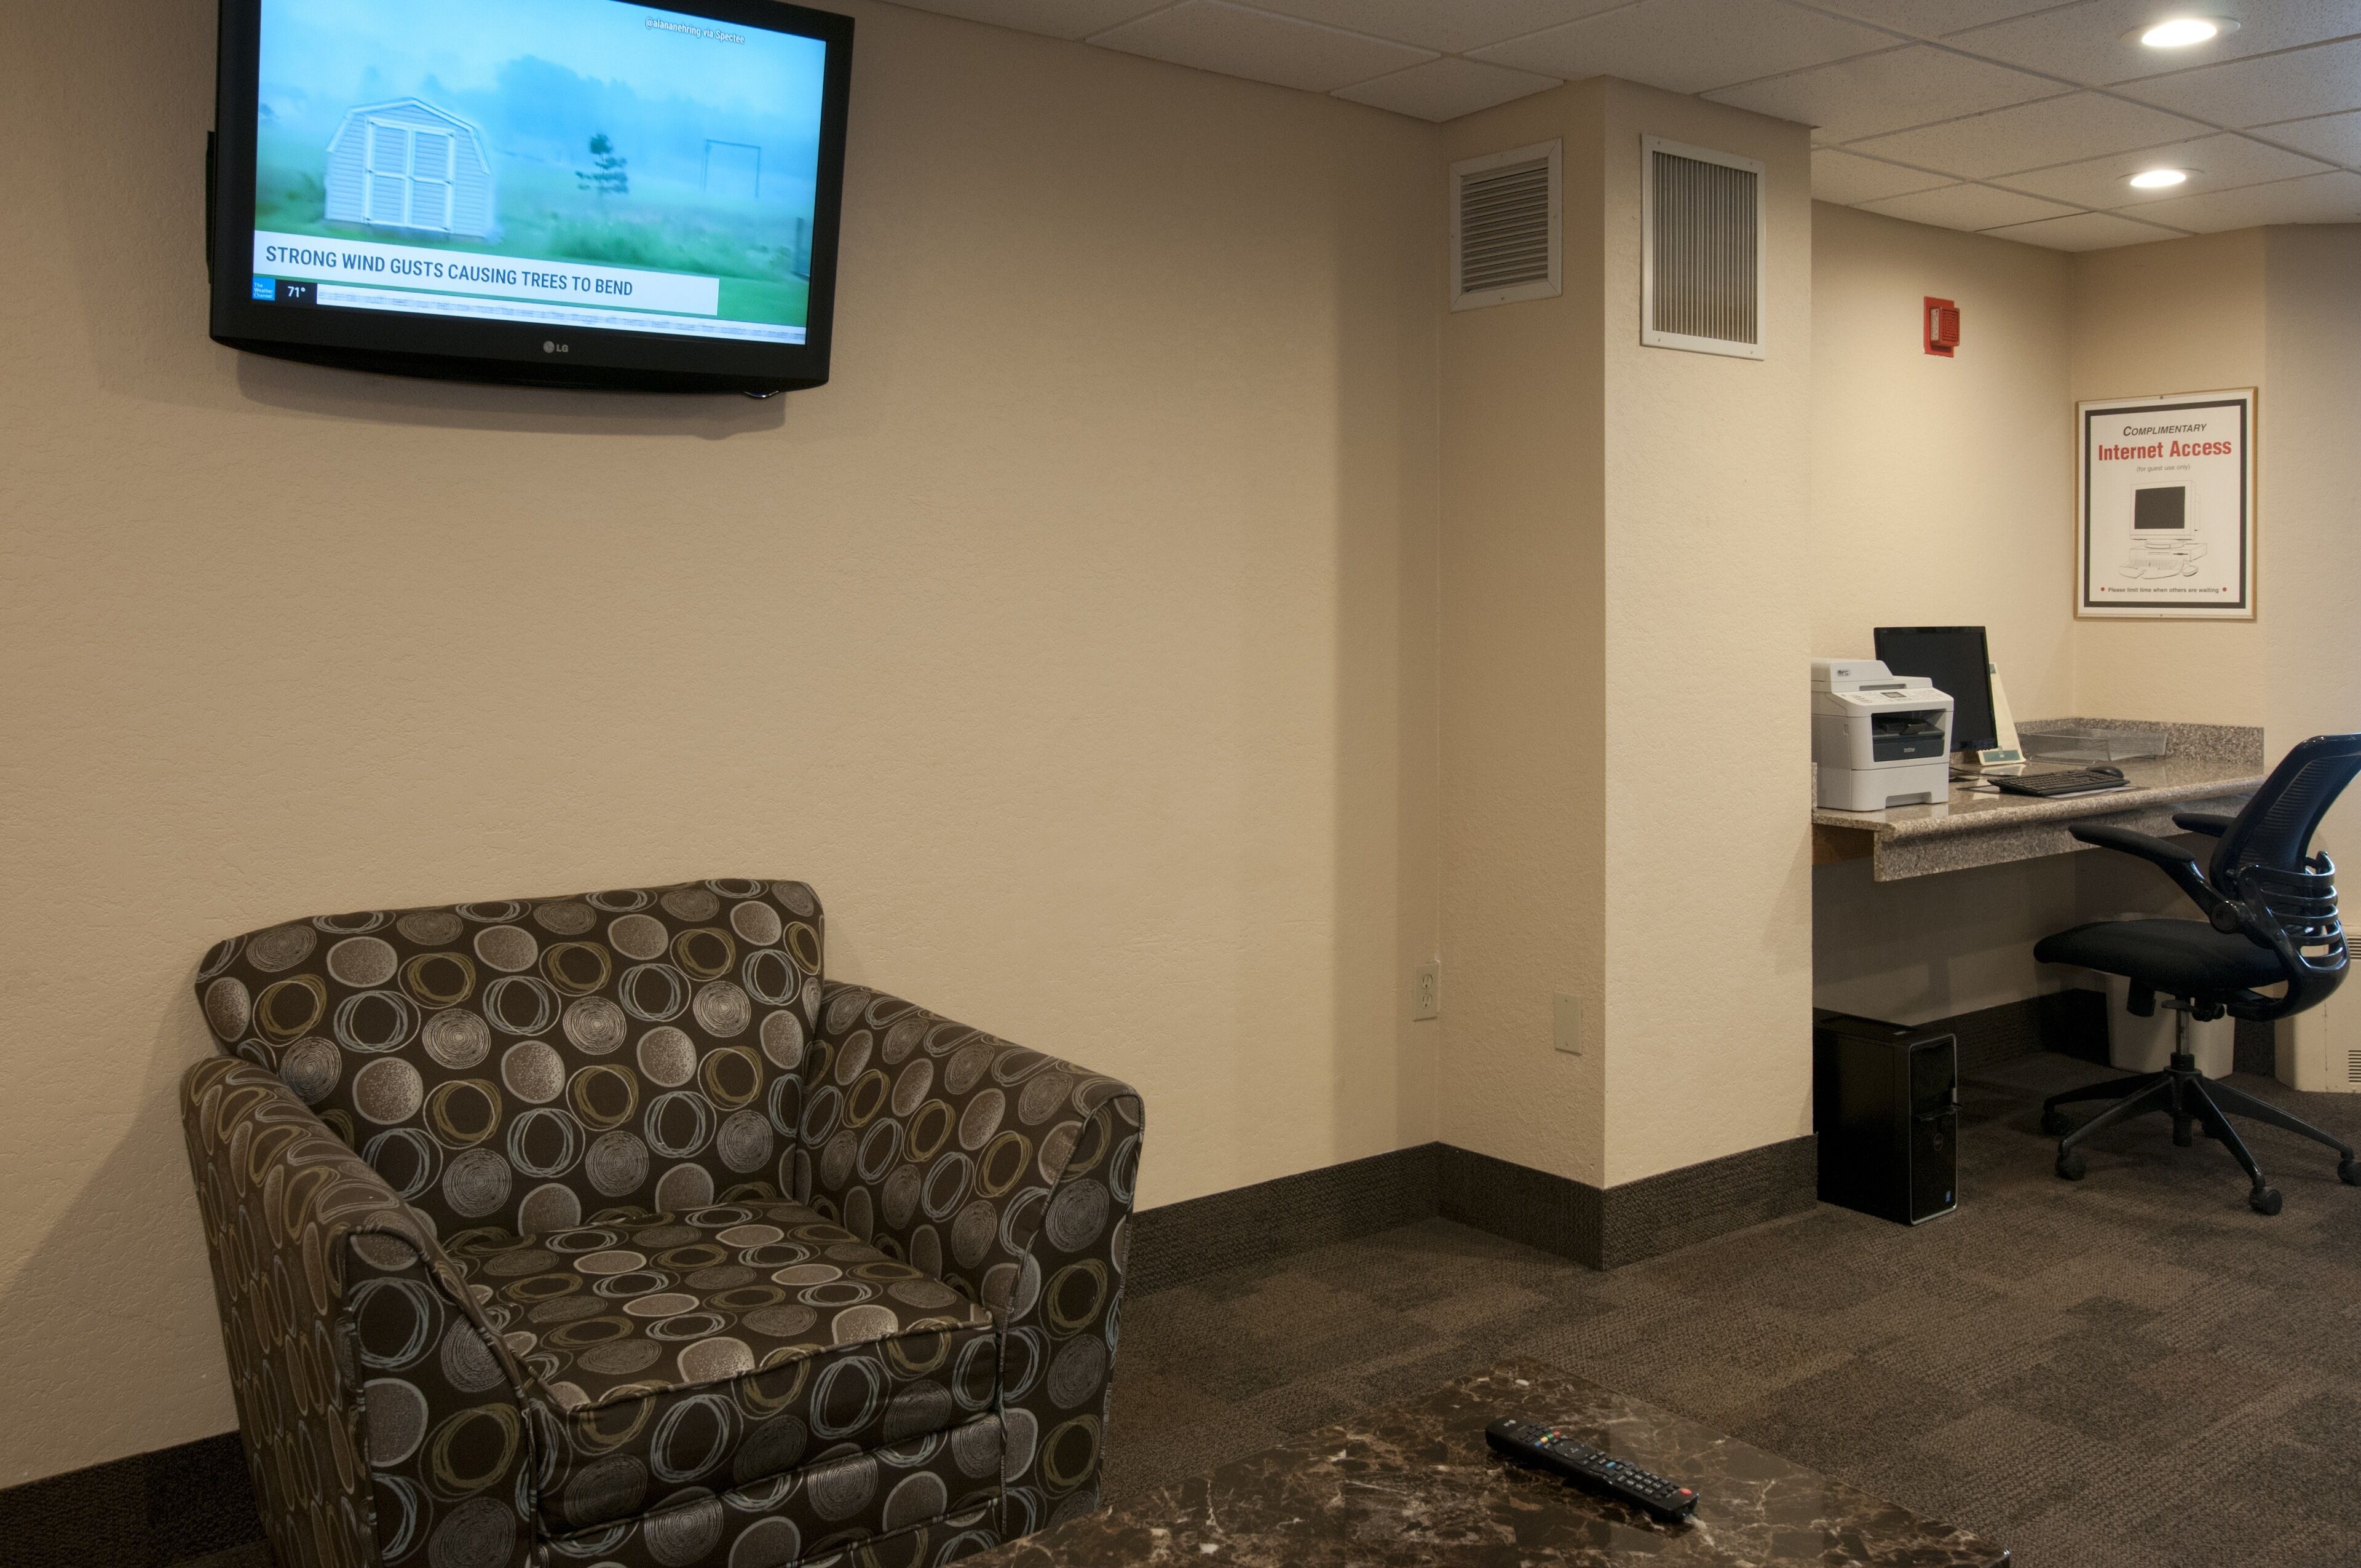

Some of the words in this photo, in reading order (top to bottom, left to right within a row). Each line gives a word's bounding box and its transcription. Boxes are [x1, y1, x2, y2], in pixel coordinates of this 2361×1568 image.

[646, 17, 701, 37] @alananehring
[703, 28, 714, 38] via
[716, 30, 745, 44] Spectee
[266, 246, 337, 267] STRONG
[342, 253, 386, 272] WIND
[390, 258, 443, 277] GUSTS
[448, 264, 517, 285] CAUSING
[521, 271, 568, 290] TREES
[572, 276, 591, 292] TO
[595, 279, 633, 296] BEND
[287, 286, 306, 298] 71°
[556, 344, 569, 352] LG
[2123, 424, 2207, 437] COMPLIMENTARY
[2098, 441, 2164, 461] Internet
[2169, 440, 2232, 457] Access
